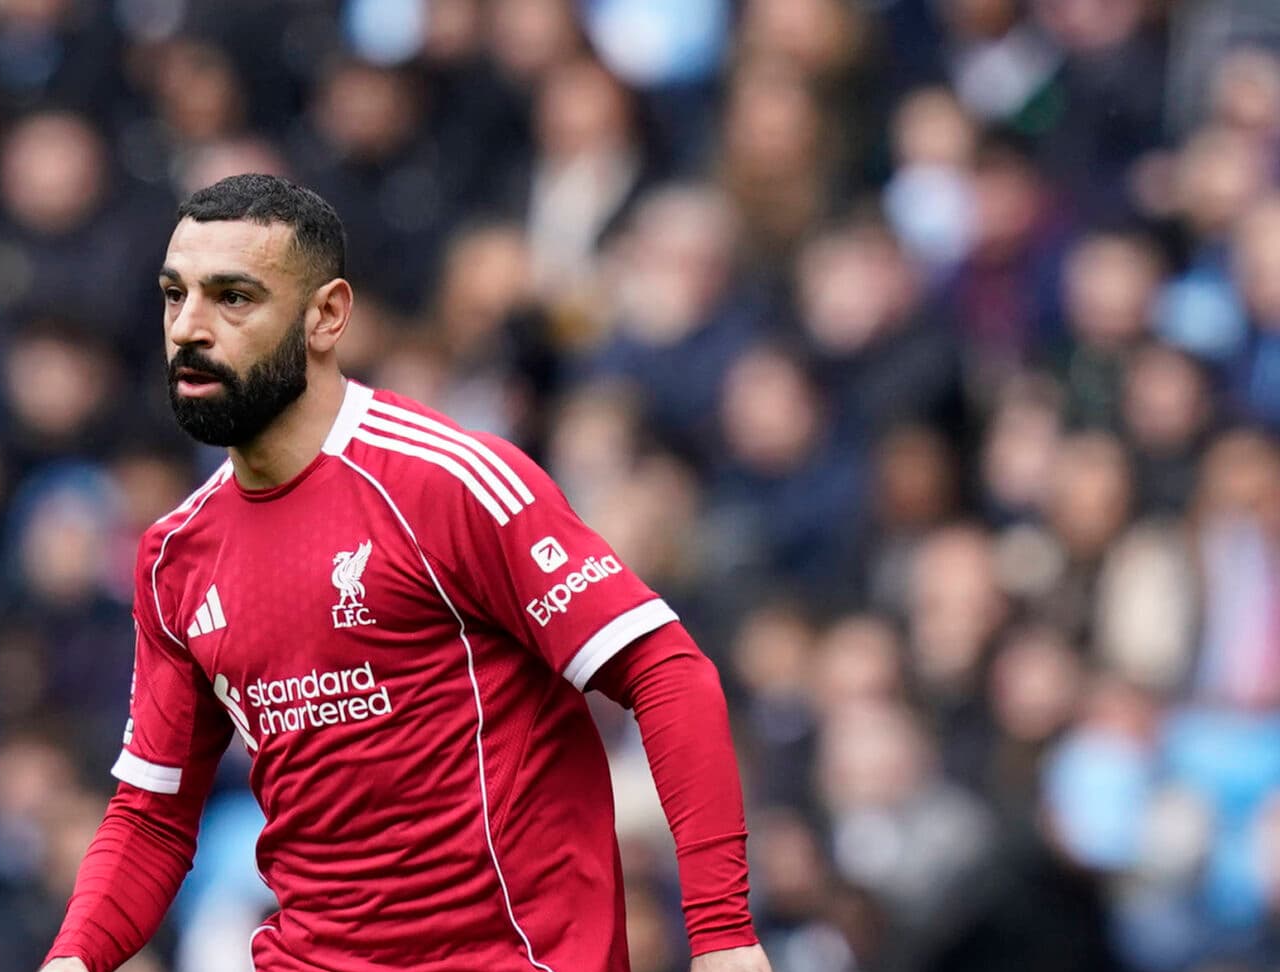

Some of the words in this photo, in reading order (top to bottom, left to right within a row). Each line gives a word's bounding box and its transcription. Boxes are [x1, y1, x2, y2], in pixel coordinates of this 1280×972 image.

[526, 554, 623, 627] Expedia
[332, 607, 377, 628] L.F.C.
[246, 661, 376, 707] standard
[259, 686, 393, 735] chartered
